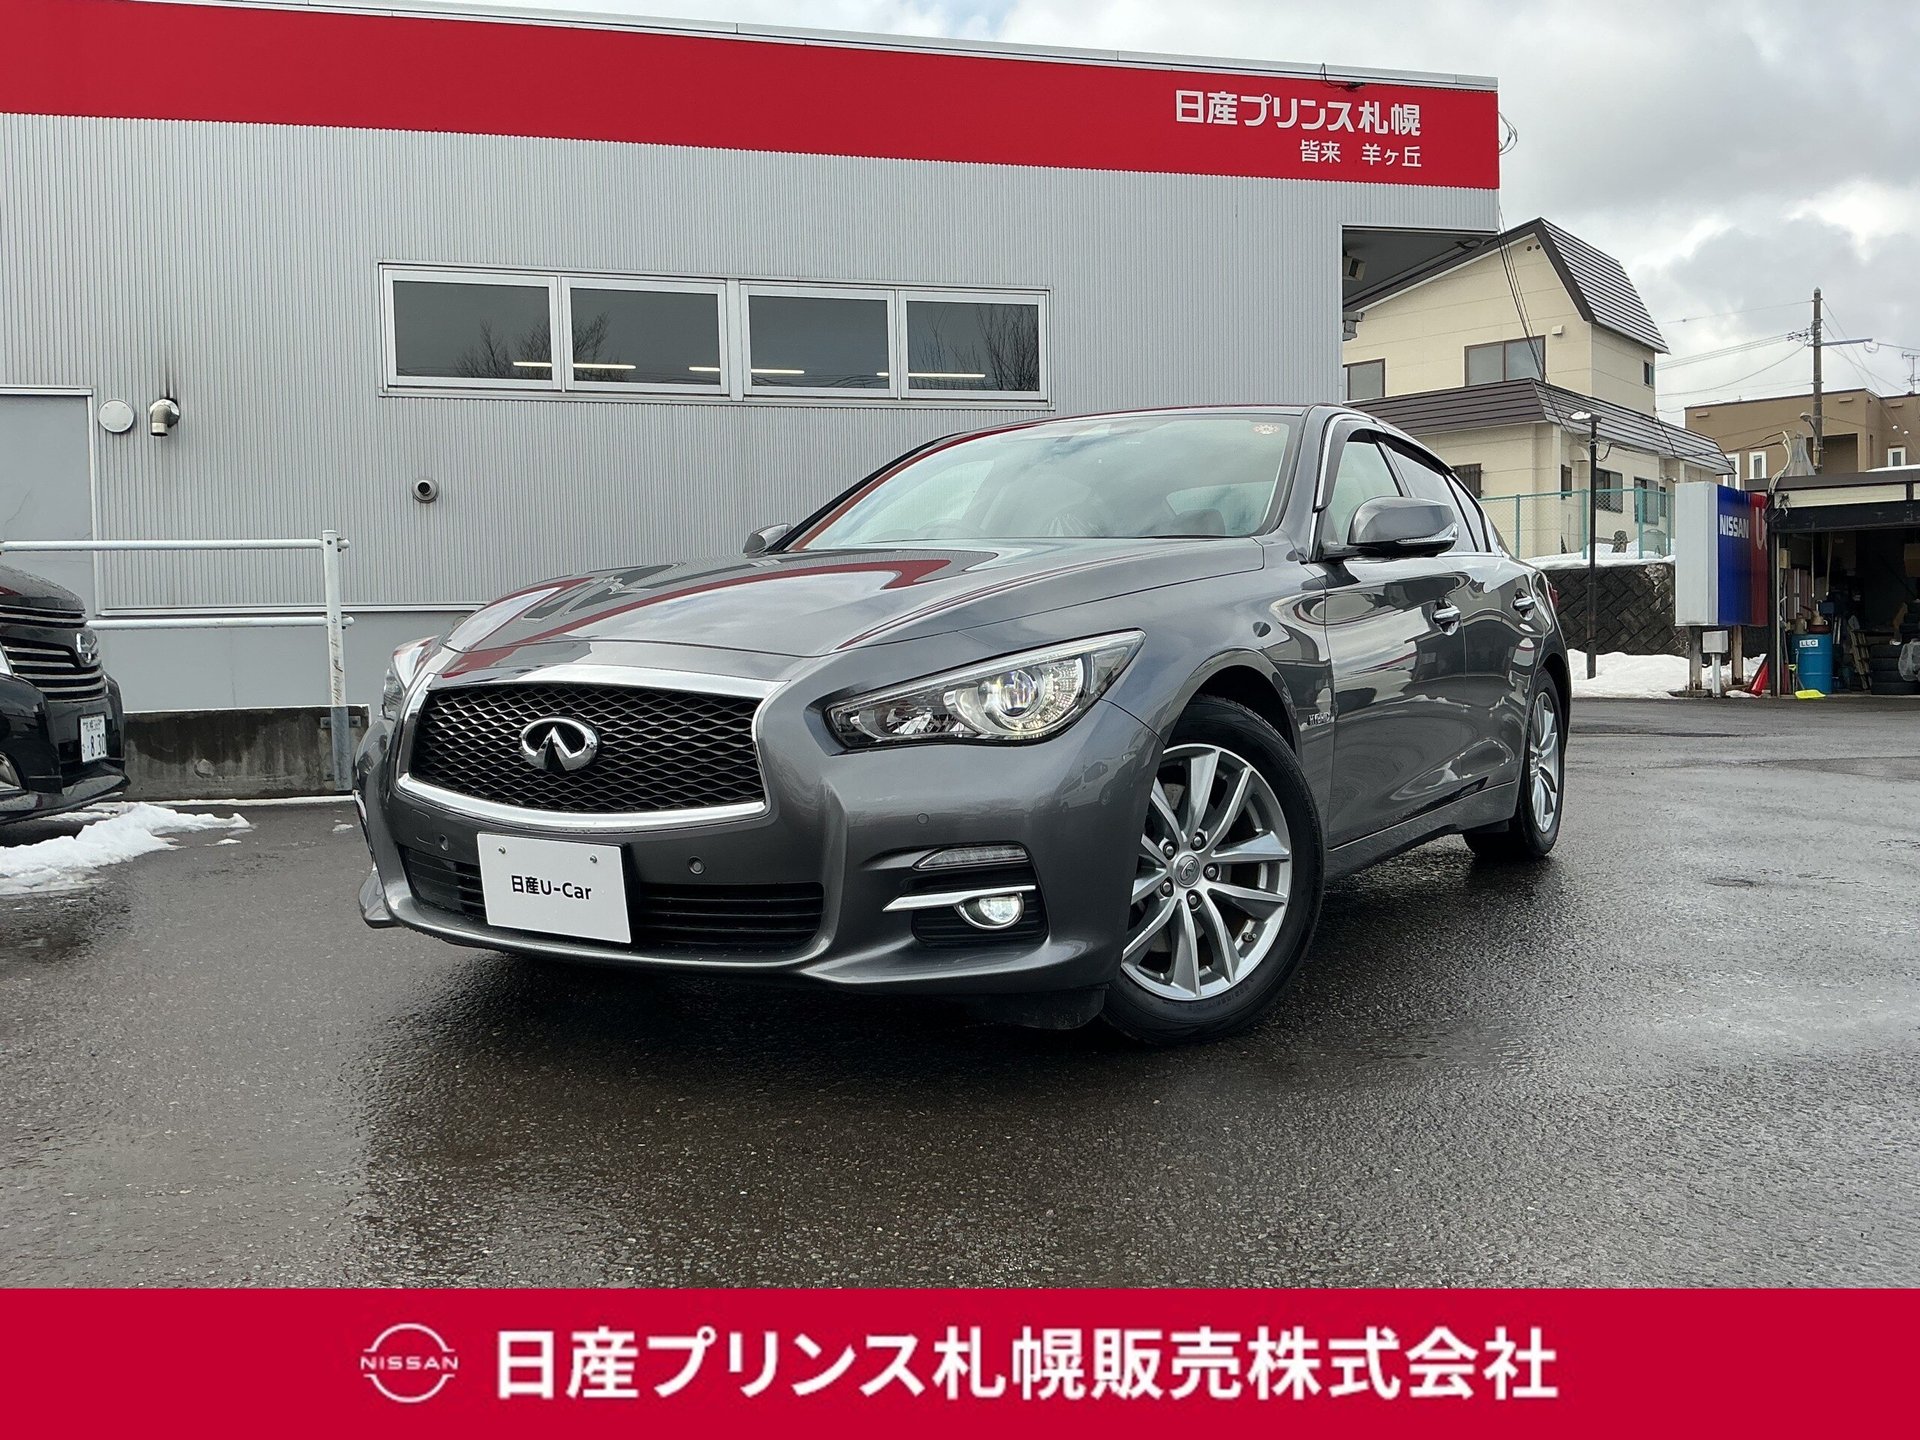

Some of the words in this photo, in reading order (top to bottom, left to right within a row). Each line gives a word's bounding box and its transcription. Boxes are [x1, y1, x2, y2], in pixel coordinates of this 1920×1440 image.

[1175, 89, 1422, 136] 日産プリンス札幌
[1300, 139, 1341, 164] 皆来
[1720, 514, 1749, 539] NISSAN
[511, 874, 592, 900] 日産U-Car
